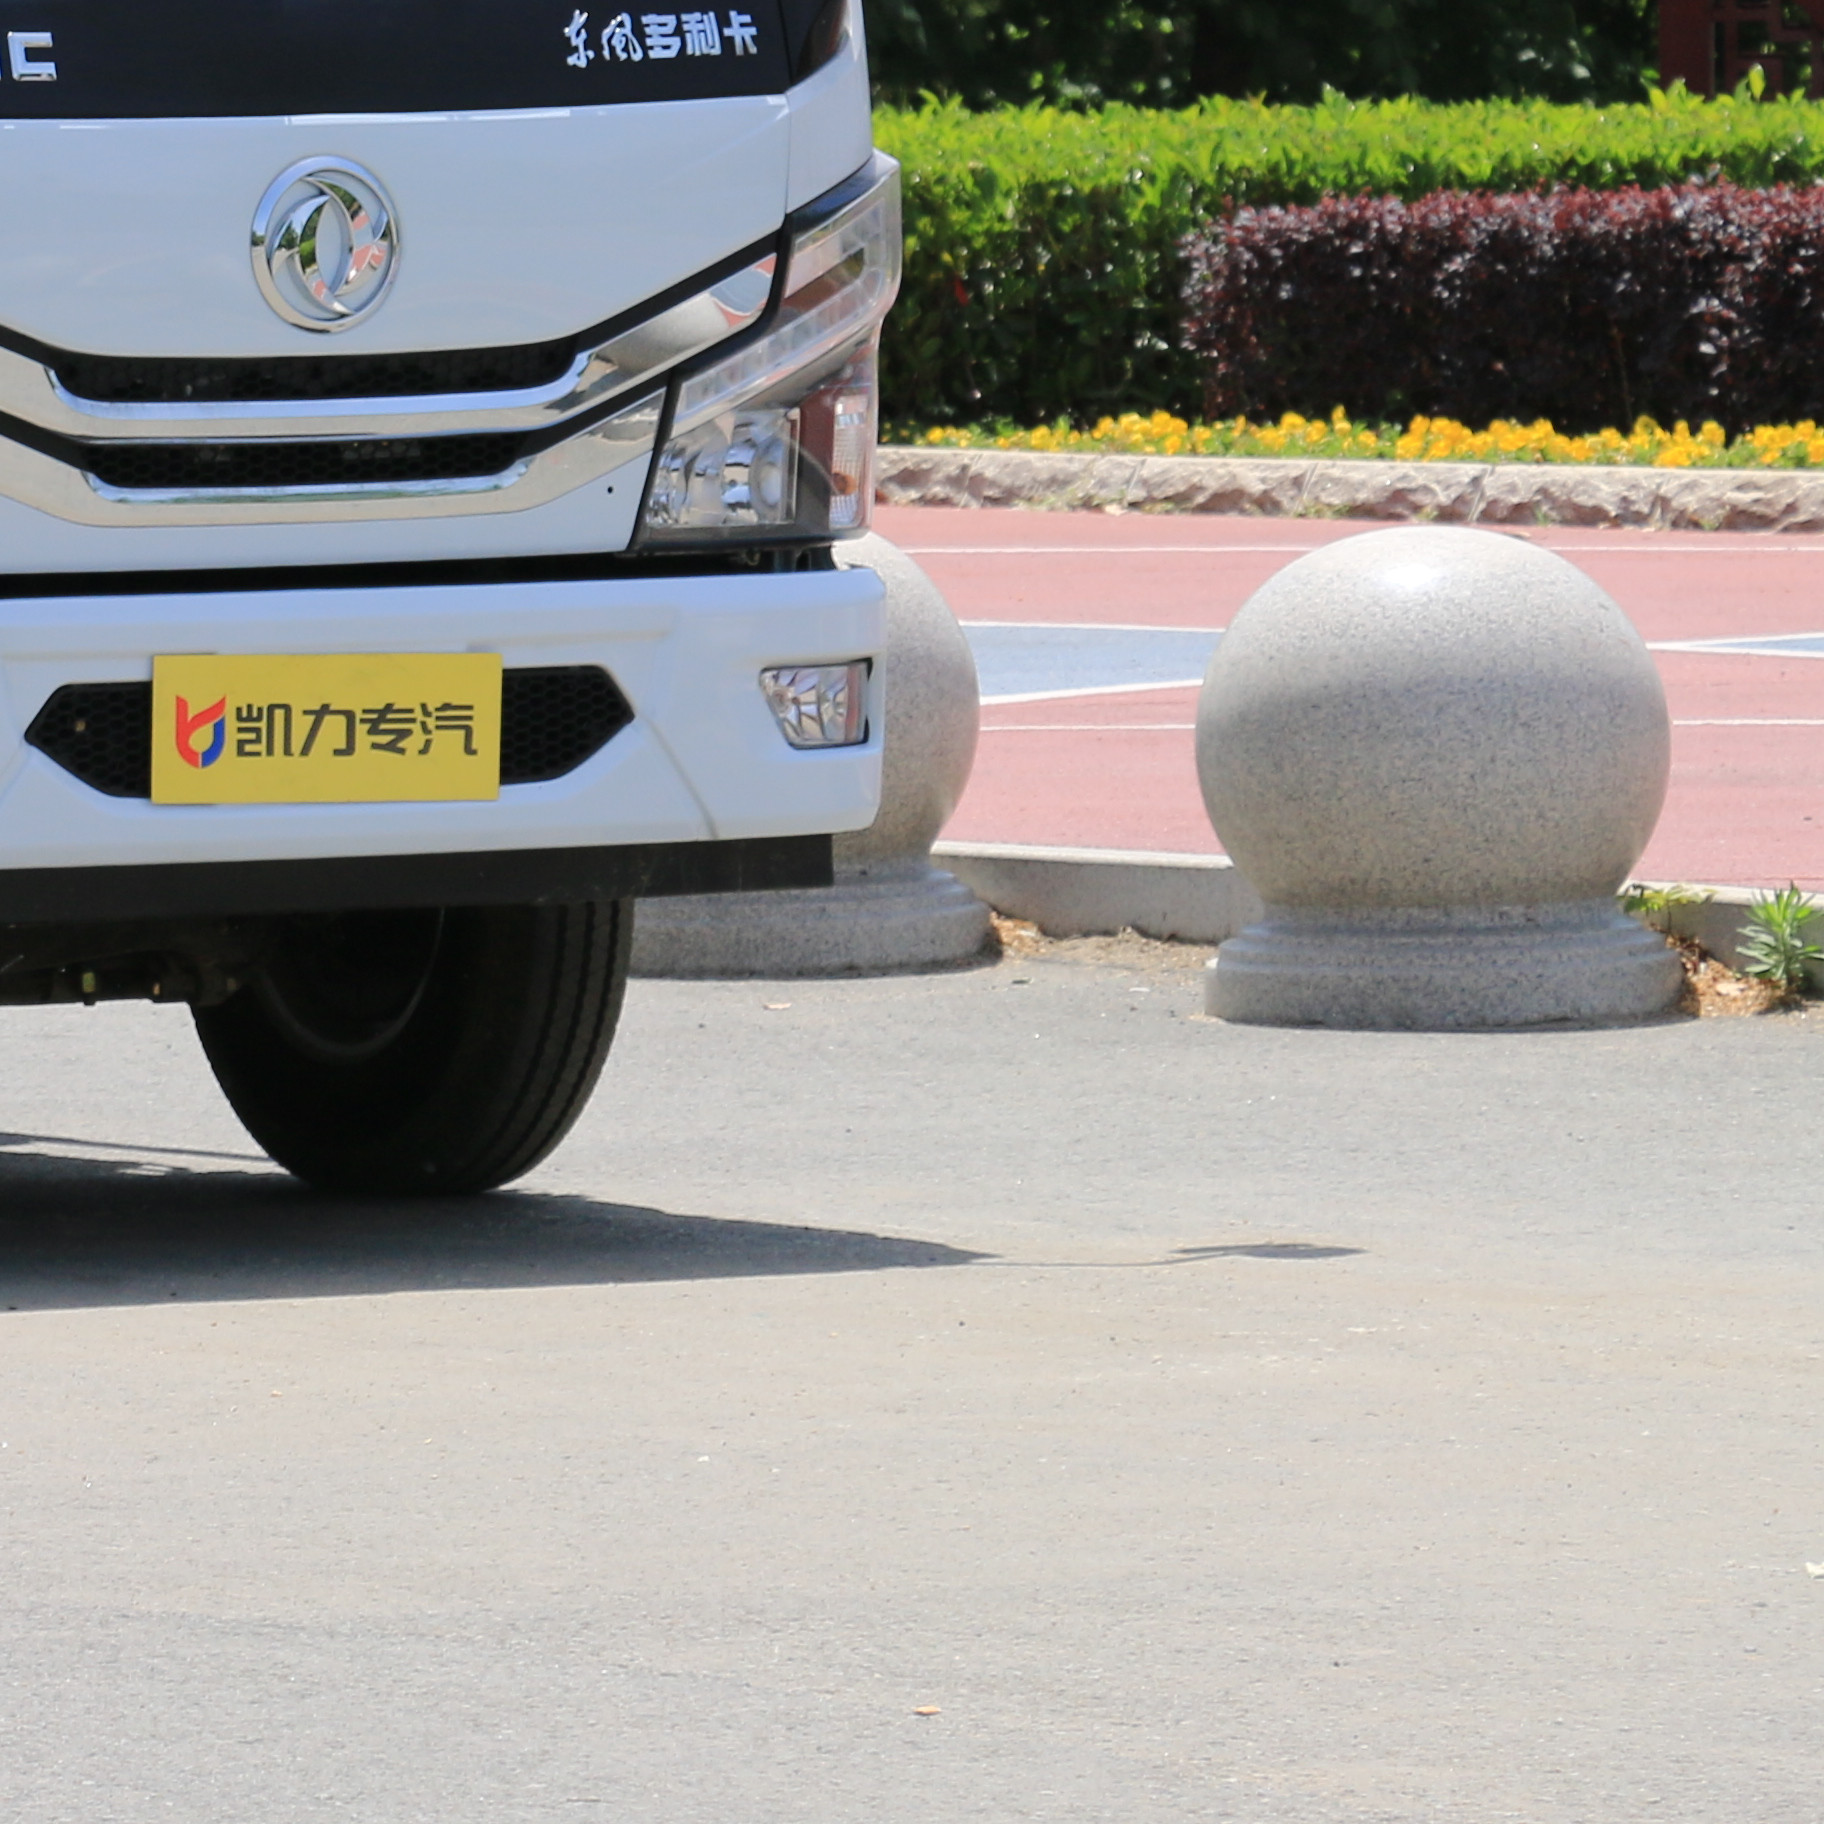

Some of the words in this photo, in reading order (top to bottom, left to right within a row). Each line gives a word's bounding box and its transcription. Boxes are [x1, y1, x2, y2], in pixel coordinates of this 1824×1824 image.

[562, 8, 759, 69] 东风多利卡
[235, 702, 479, 758] 凯力专汽
